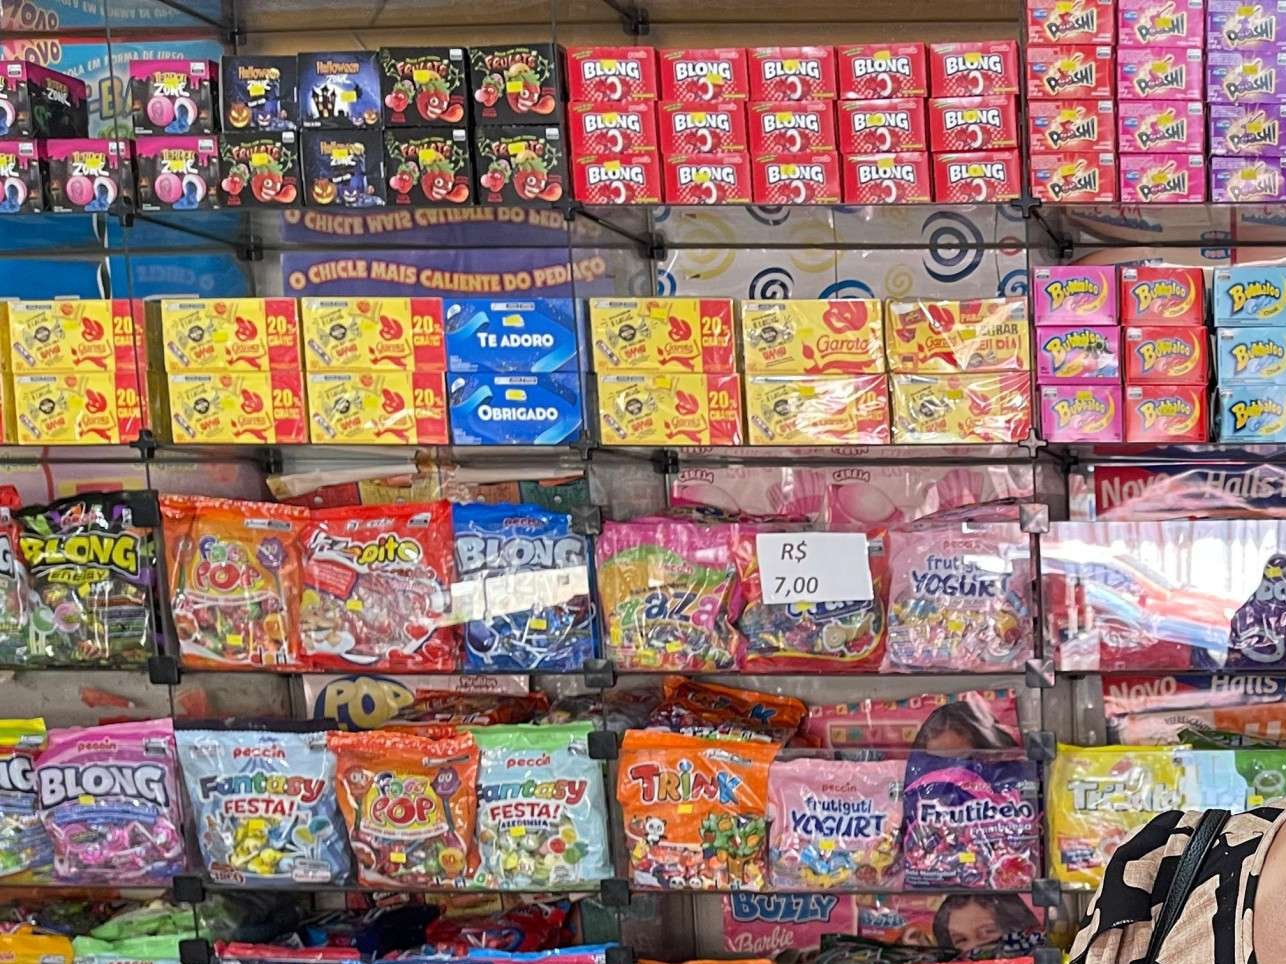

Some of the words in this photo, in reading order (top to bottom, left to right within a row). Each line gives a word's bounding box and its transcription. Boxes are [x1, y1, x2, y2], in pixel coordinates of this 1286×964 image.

[675, 60, 732, 82] BLONG
[289, 273, 305, 289] O
[309, 259, 367, 284] CHICLE
[370, 261, 417, 283] MAIS
[419, 272, 501, 292] CALIENTE
[503, 274, 532, 290] DO
[477, 333, 498, 348] TE
[500, 332, 554, 347] ADORO
[478, 405, 558, 421] OBRIGADO
[1204, 469, 1278, 499] Halls
[19, 534, 140, 568] BLONG
[781, 541, 808, 562] R$
[51, 567, 108, 583] ENERGY
[774, 575, 819, 596] 7,00
[233, 745, 286, 761] peccin
[40, 763, 168, 806] BLONG
[202, 774, 326, 801] Fantasy
[224, 799, 298, 819] FESTA!
[372, 795, 435, 825] POP
[489, 801, 561, 822] FESTA!
[805, 797, 872, 815] frutiguti
[791, 811, 887, 838] YOGURT
